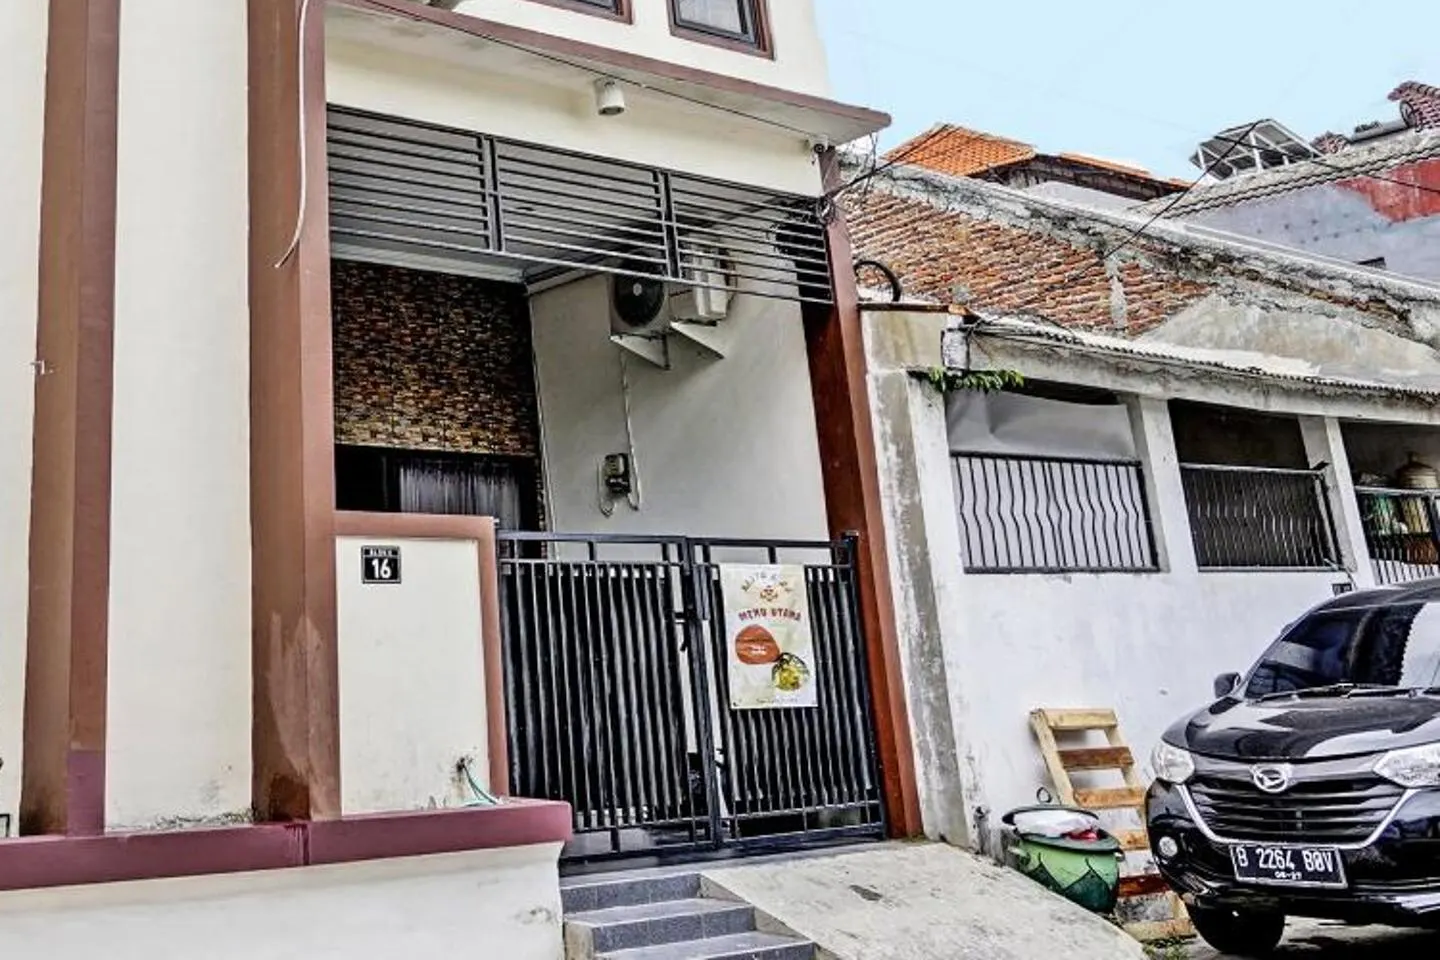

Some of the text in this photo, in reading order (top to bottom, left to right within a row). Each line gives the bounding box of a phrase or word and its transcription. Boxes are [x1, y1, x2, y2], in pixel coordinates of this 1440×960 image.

[372, 558, 391, 579] 16
[1236, 846, 1249, 867] B
[1256, 847, 1295, 870] 2264
